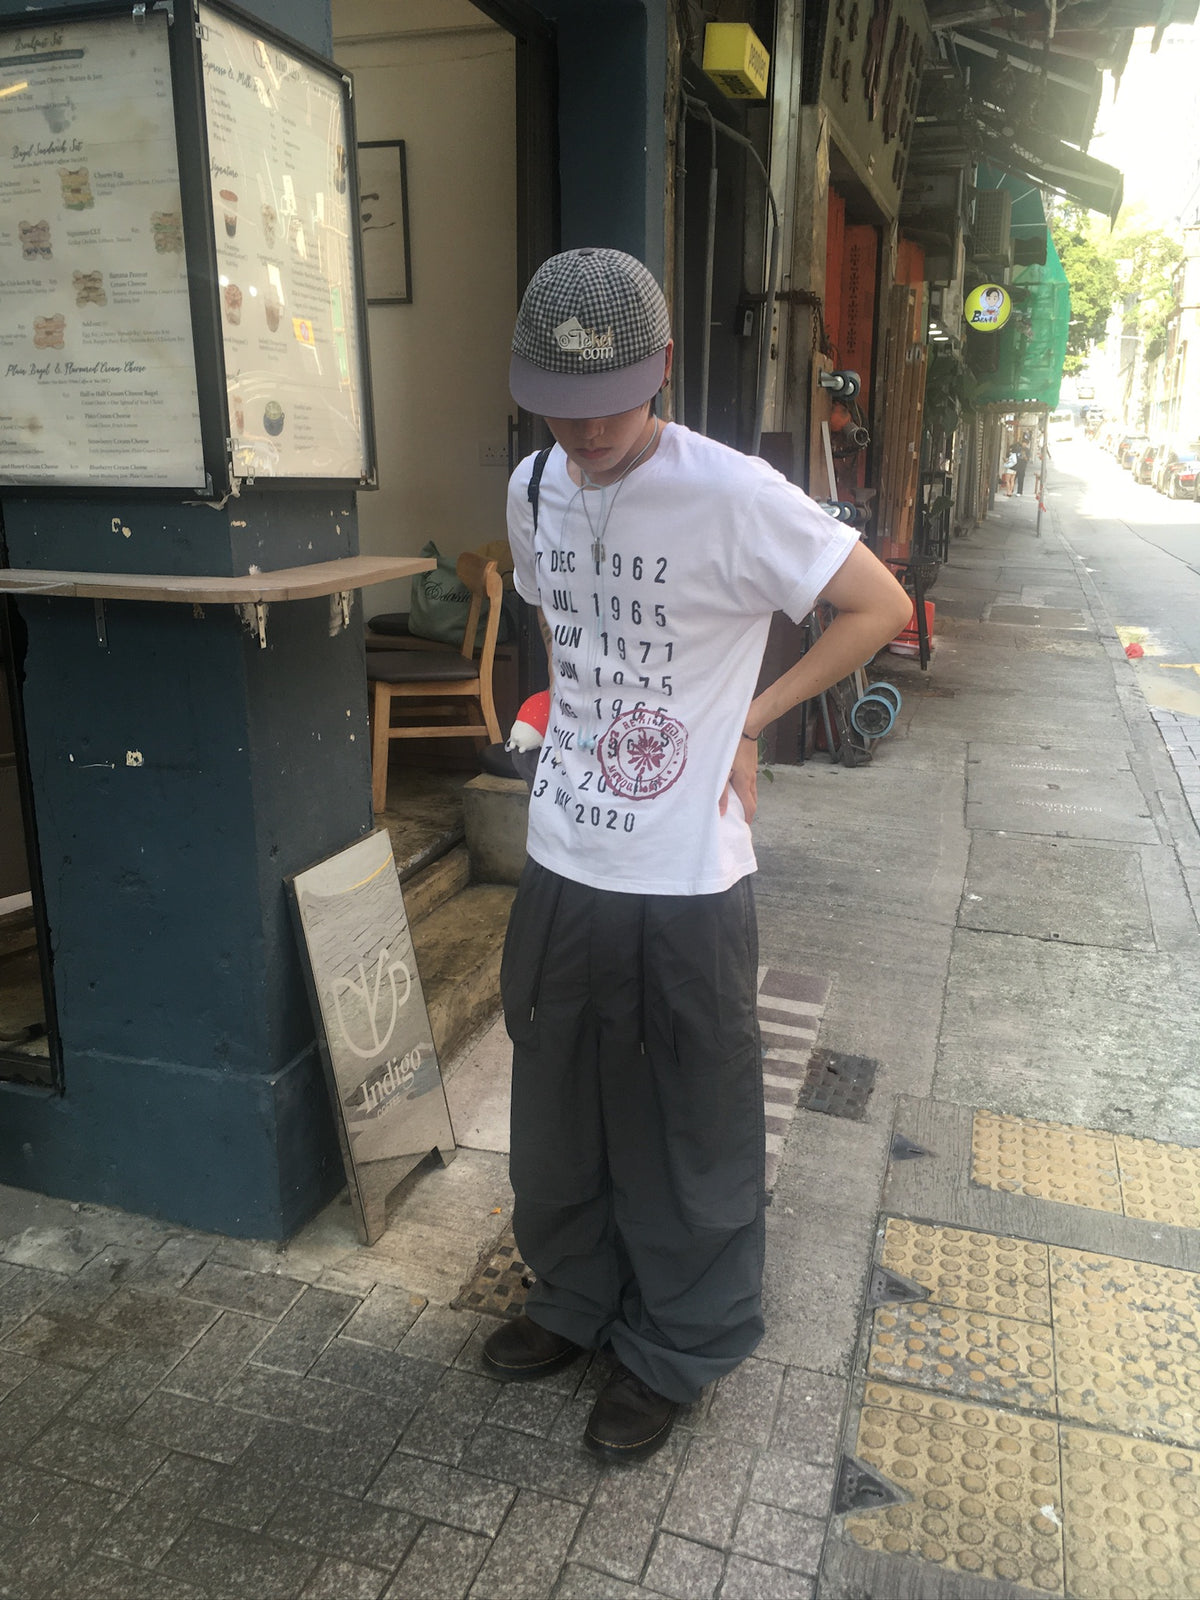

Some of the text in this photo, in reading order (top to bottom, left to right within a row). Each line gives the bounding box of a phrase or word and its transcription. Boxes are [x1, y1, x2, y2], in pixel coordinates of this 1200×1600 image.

[551, 549, 575, 573] DEC
[553, 589, 578, 613] JUL
[593, 592, 666, 627] 1965
[600, 632, 674, 664] 1971
[534, 779, 548, 798] 3
[575, 803, 636, 833] 2020
[356, 1048, 421, 1114] Indigo
